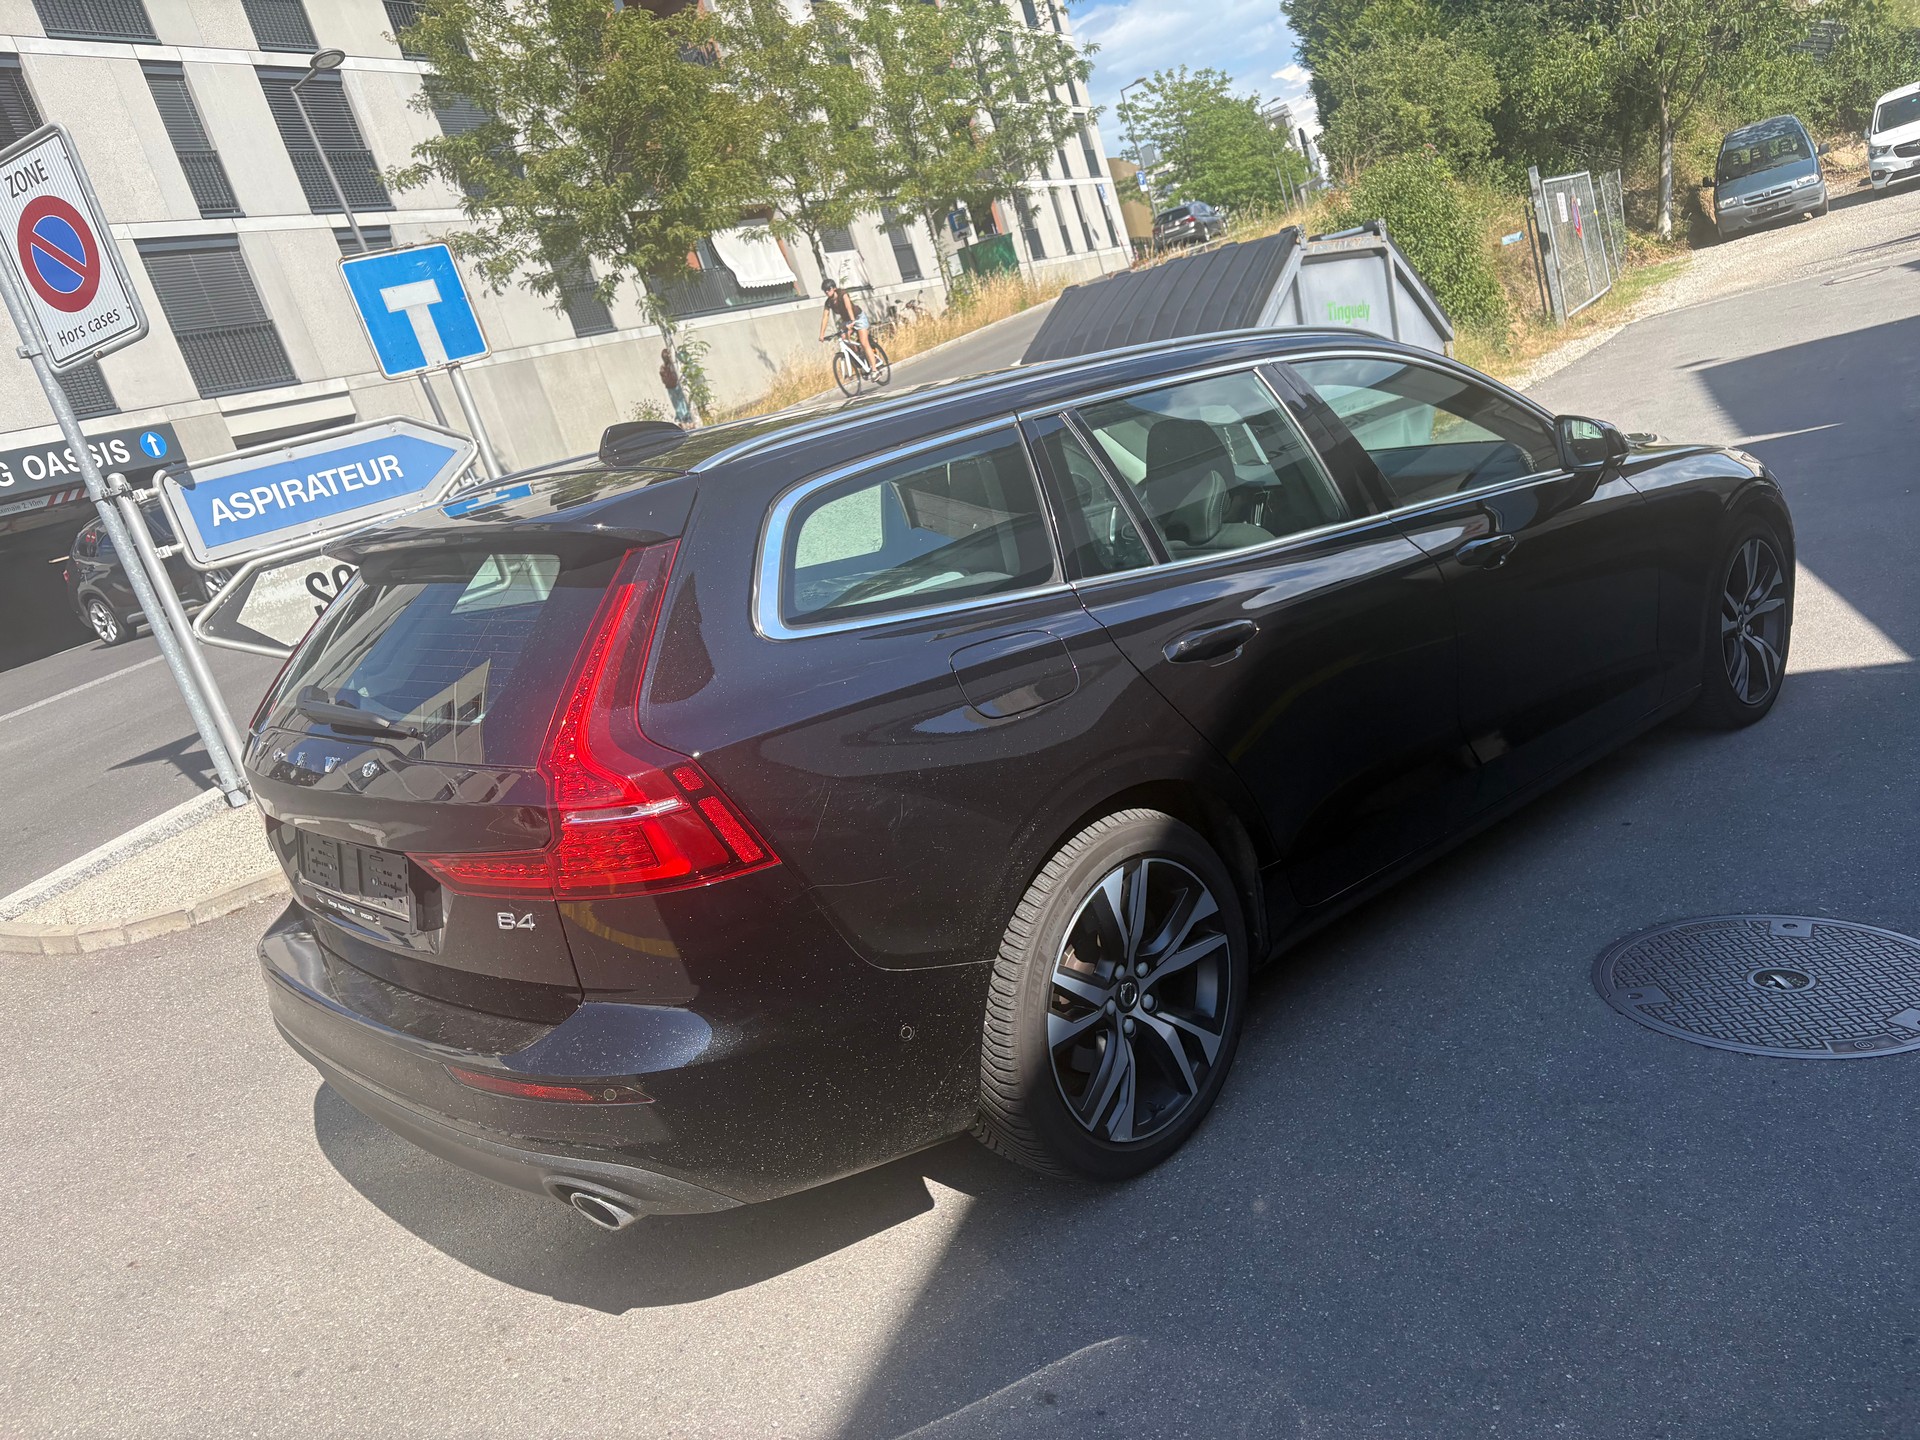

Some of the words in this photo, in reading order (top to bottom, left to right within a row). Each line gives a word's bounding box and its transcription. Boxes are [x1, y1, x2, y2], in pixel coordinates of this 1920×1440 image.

[4, 159, 49, 199] ZONE
[57, 323, 86, 347] Hors
[88, 307, 121, 333] cases
[1327, 298, 1370, 323] Tinguely
[211, 454, 405, 527] ASPIRATEUR
[497, 911, 536, 931] B4
